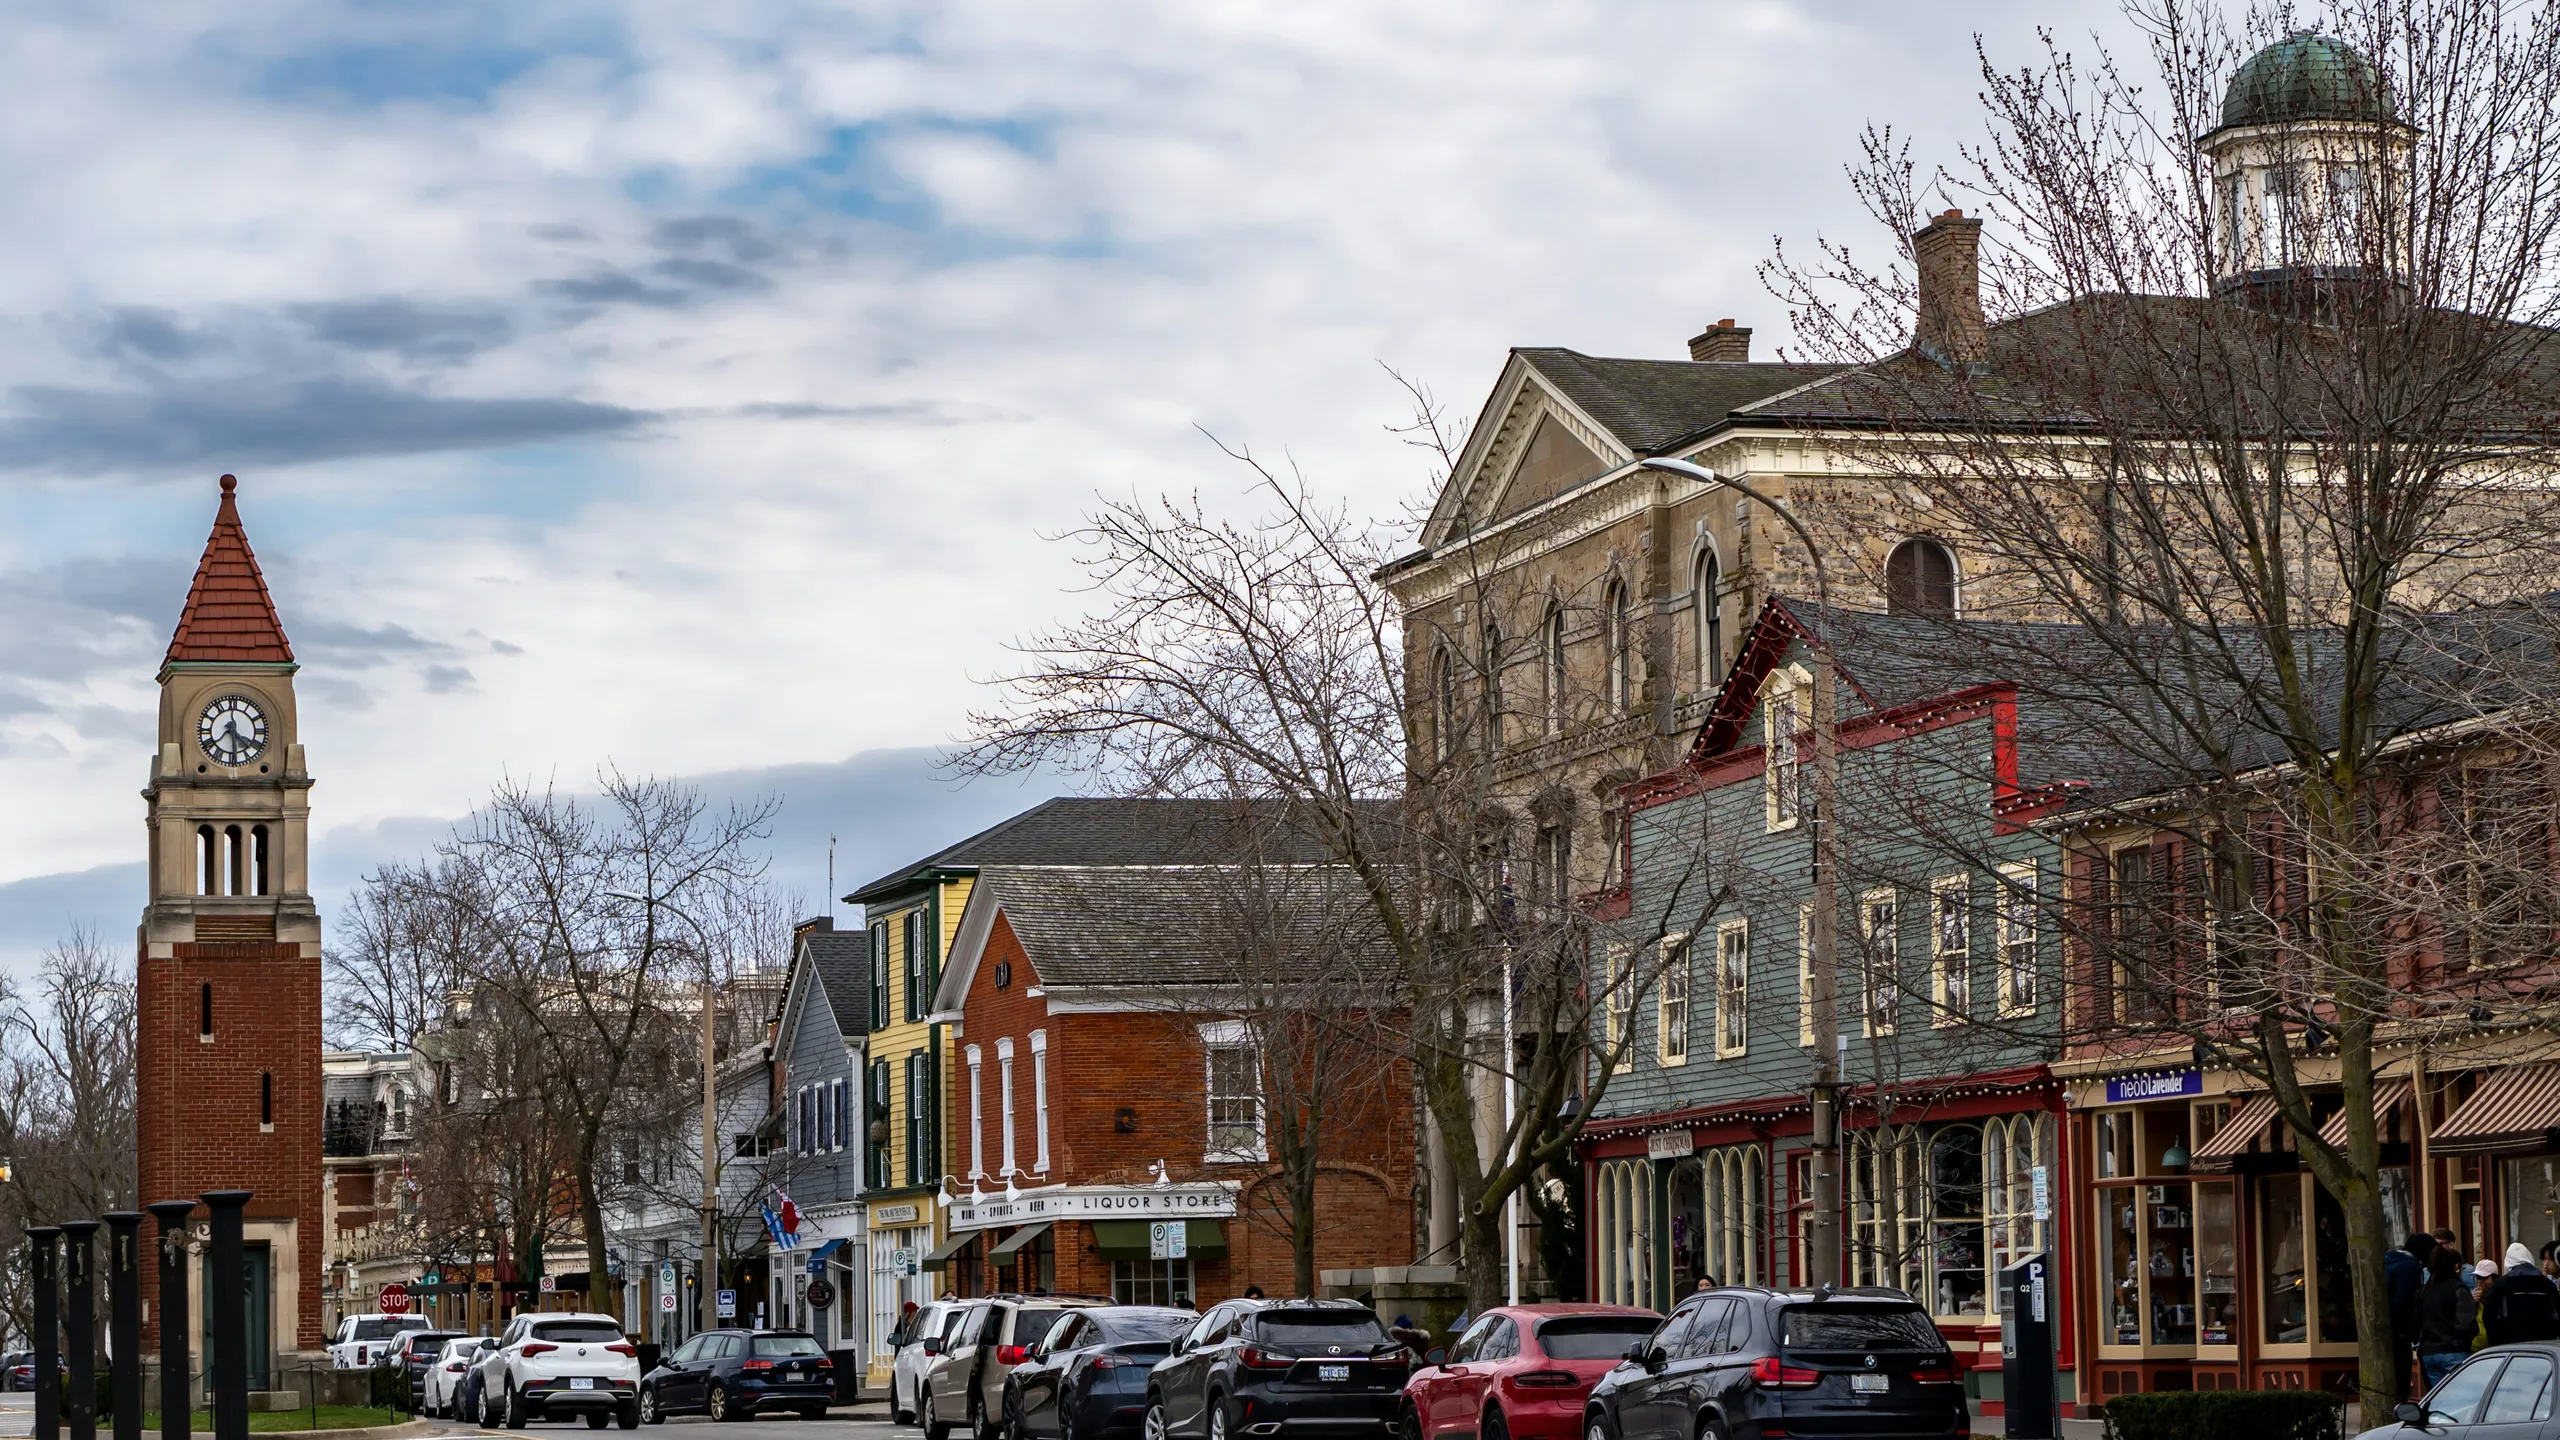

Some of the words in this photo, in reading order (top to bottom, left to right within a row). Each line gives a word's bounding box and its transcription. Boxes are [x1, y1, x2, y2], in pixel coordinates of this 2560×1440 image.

[2120, 1074, 2183, 1098] neobLavender
[1649, 1139, 1661, 1152] JUST
[1083, 1196, 1150, 1209] LIQUOR
[1163, 1195, 1221, 1208] STORE
[961, 1209, 975, 1220] WINE
[989, 1204, 1013, 1217] SPIRITS
[1029, 1200, 1044, 1212] BEER
[1156, 1228, 1162, 1237] P
[2029, 1263, 2043, 1281] P
[2020, 1284, 2030, 1293] Q2
[381, 1295, 410, 1307] STOP
